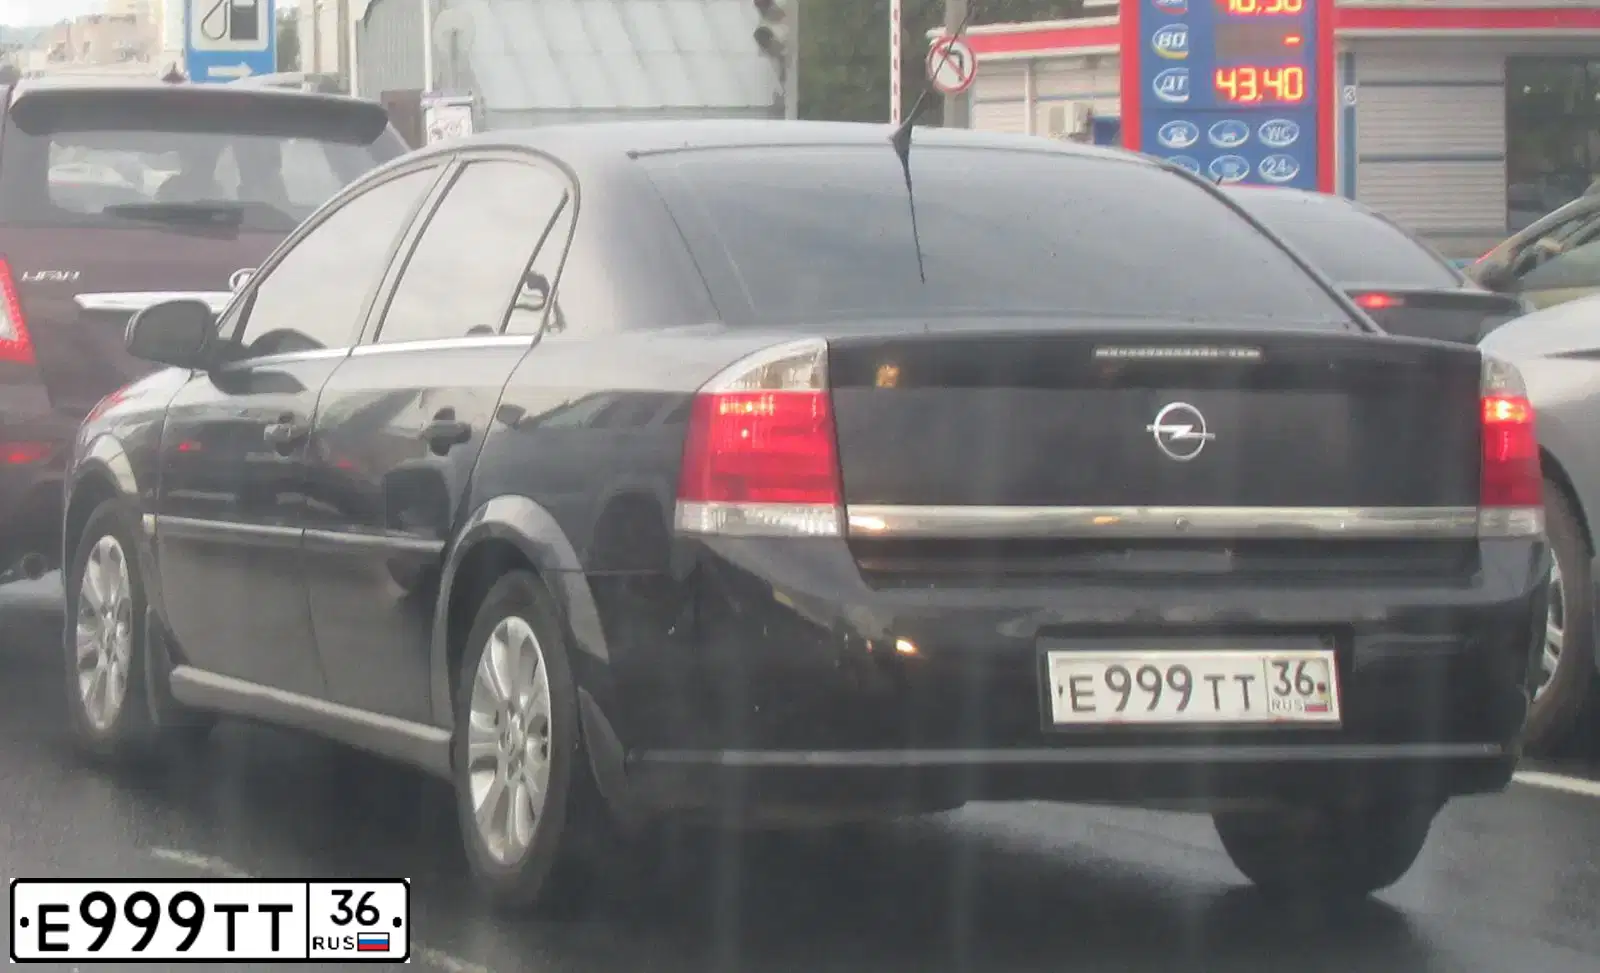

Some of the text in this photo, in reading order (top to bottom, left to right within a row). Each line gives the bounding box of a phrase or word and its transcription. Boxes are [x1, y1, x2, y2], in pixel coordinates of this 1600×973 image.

[1266, 125, 1291, 141] WC
[1271, 660, 1315, 698] 36
[1271, 699, 1304, 713] RUS
